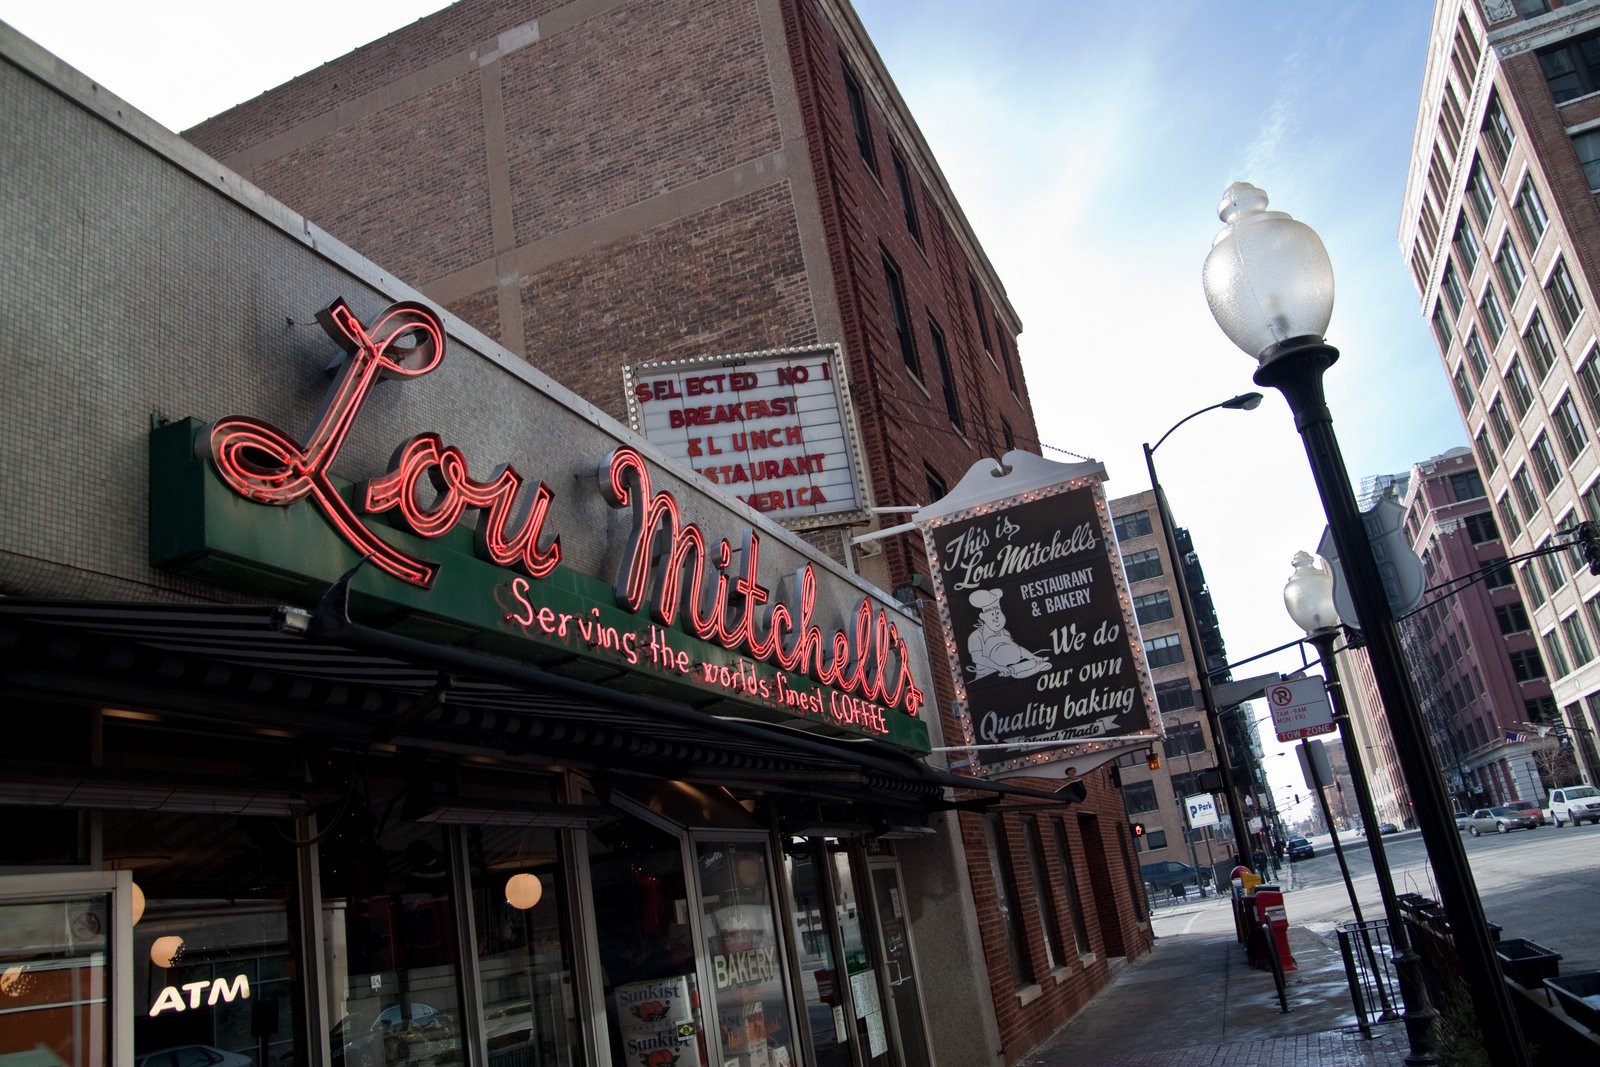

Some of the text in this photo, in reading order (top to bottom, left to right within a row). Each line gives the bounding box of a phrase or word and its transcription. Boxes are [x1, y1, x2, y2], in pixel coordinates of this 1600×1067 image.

[635, 371, 759, 403] SELECTED
[777, 365, 809, 387] NO
[669, 396, 798, 429] BREAKFAST
[203, 300, 924, 717] Lou Mitchell's
[943, 515, 1021, 572] This is
[953, 521, 1101, 591] Lou Mitchells
[1020, 567, 1094, 600] RESTAURANT
[1031, 587, 1092, 617] & BAKERY
[509, 577, 638, 665] Serving
[650, 625, 690, 673] the
[831, 690, 890, 734] COFFEE
[1050, 622, 1120, 656] We do
[1037, 656, 1123, 693] our own
[980, 685, 1135, 743] Quality baking
[1061, 725, 1100, 740] Made
[1281, 724, 1331, 740] TOW ZONE
[1197, 801, 1213, 811] Park
[713, 946, 775, 990] BAKERY
[150, 974, 251, 1017] ATM
[619, 984, 681, 1007] Sunkist
